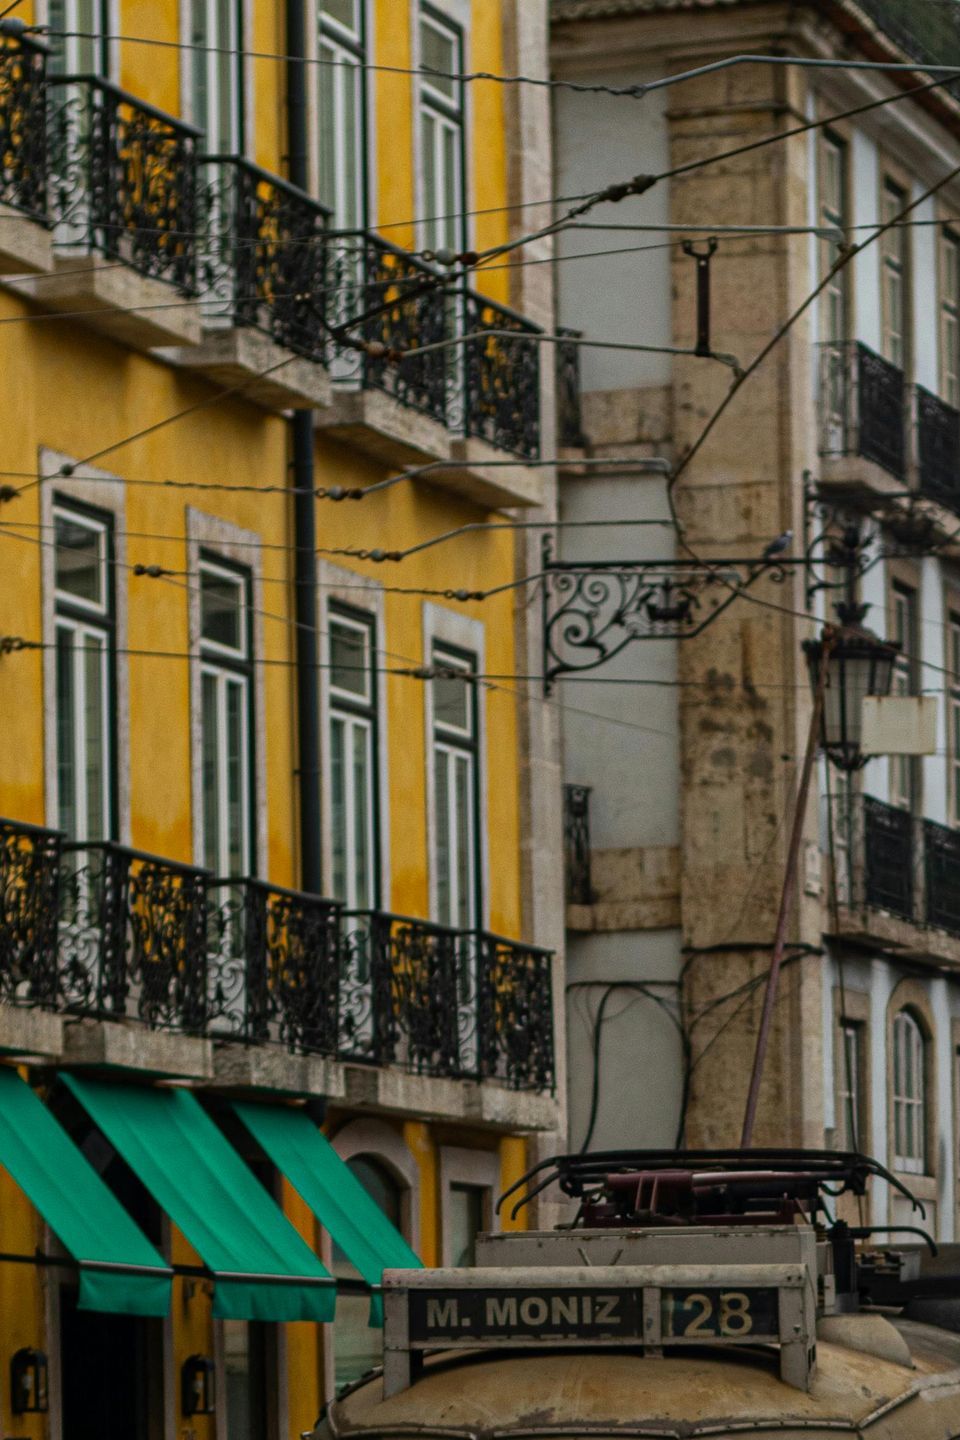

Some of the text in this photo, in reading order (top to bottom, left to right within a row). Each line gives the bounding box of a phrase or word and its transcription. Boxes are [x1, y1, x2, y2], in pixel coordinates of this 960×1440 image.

[426, 1295, 621, 1328] M. MONIZ
[683, 1292, 753, 1337] 28
